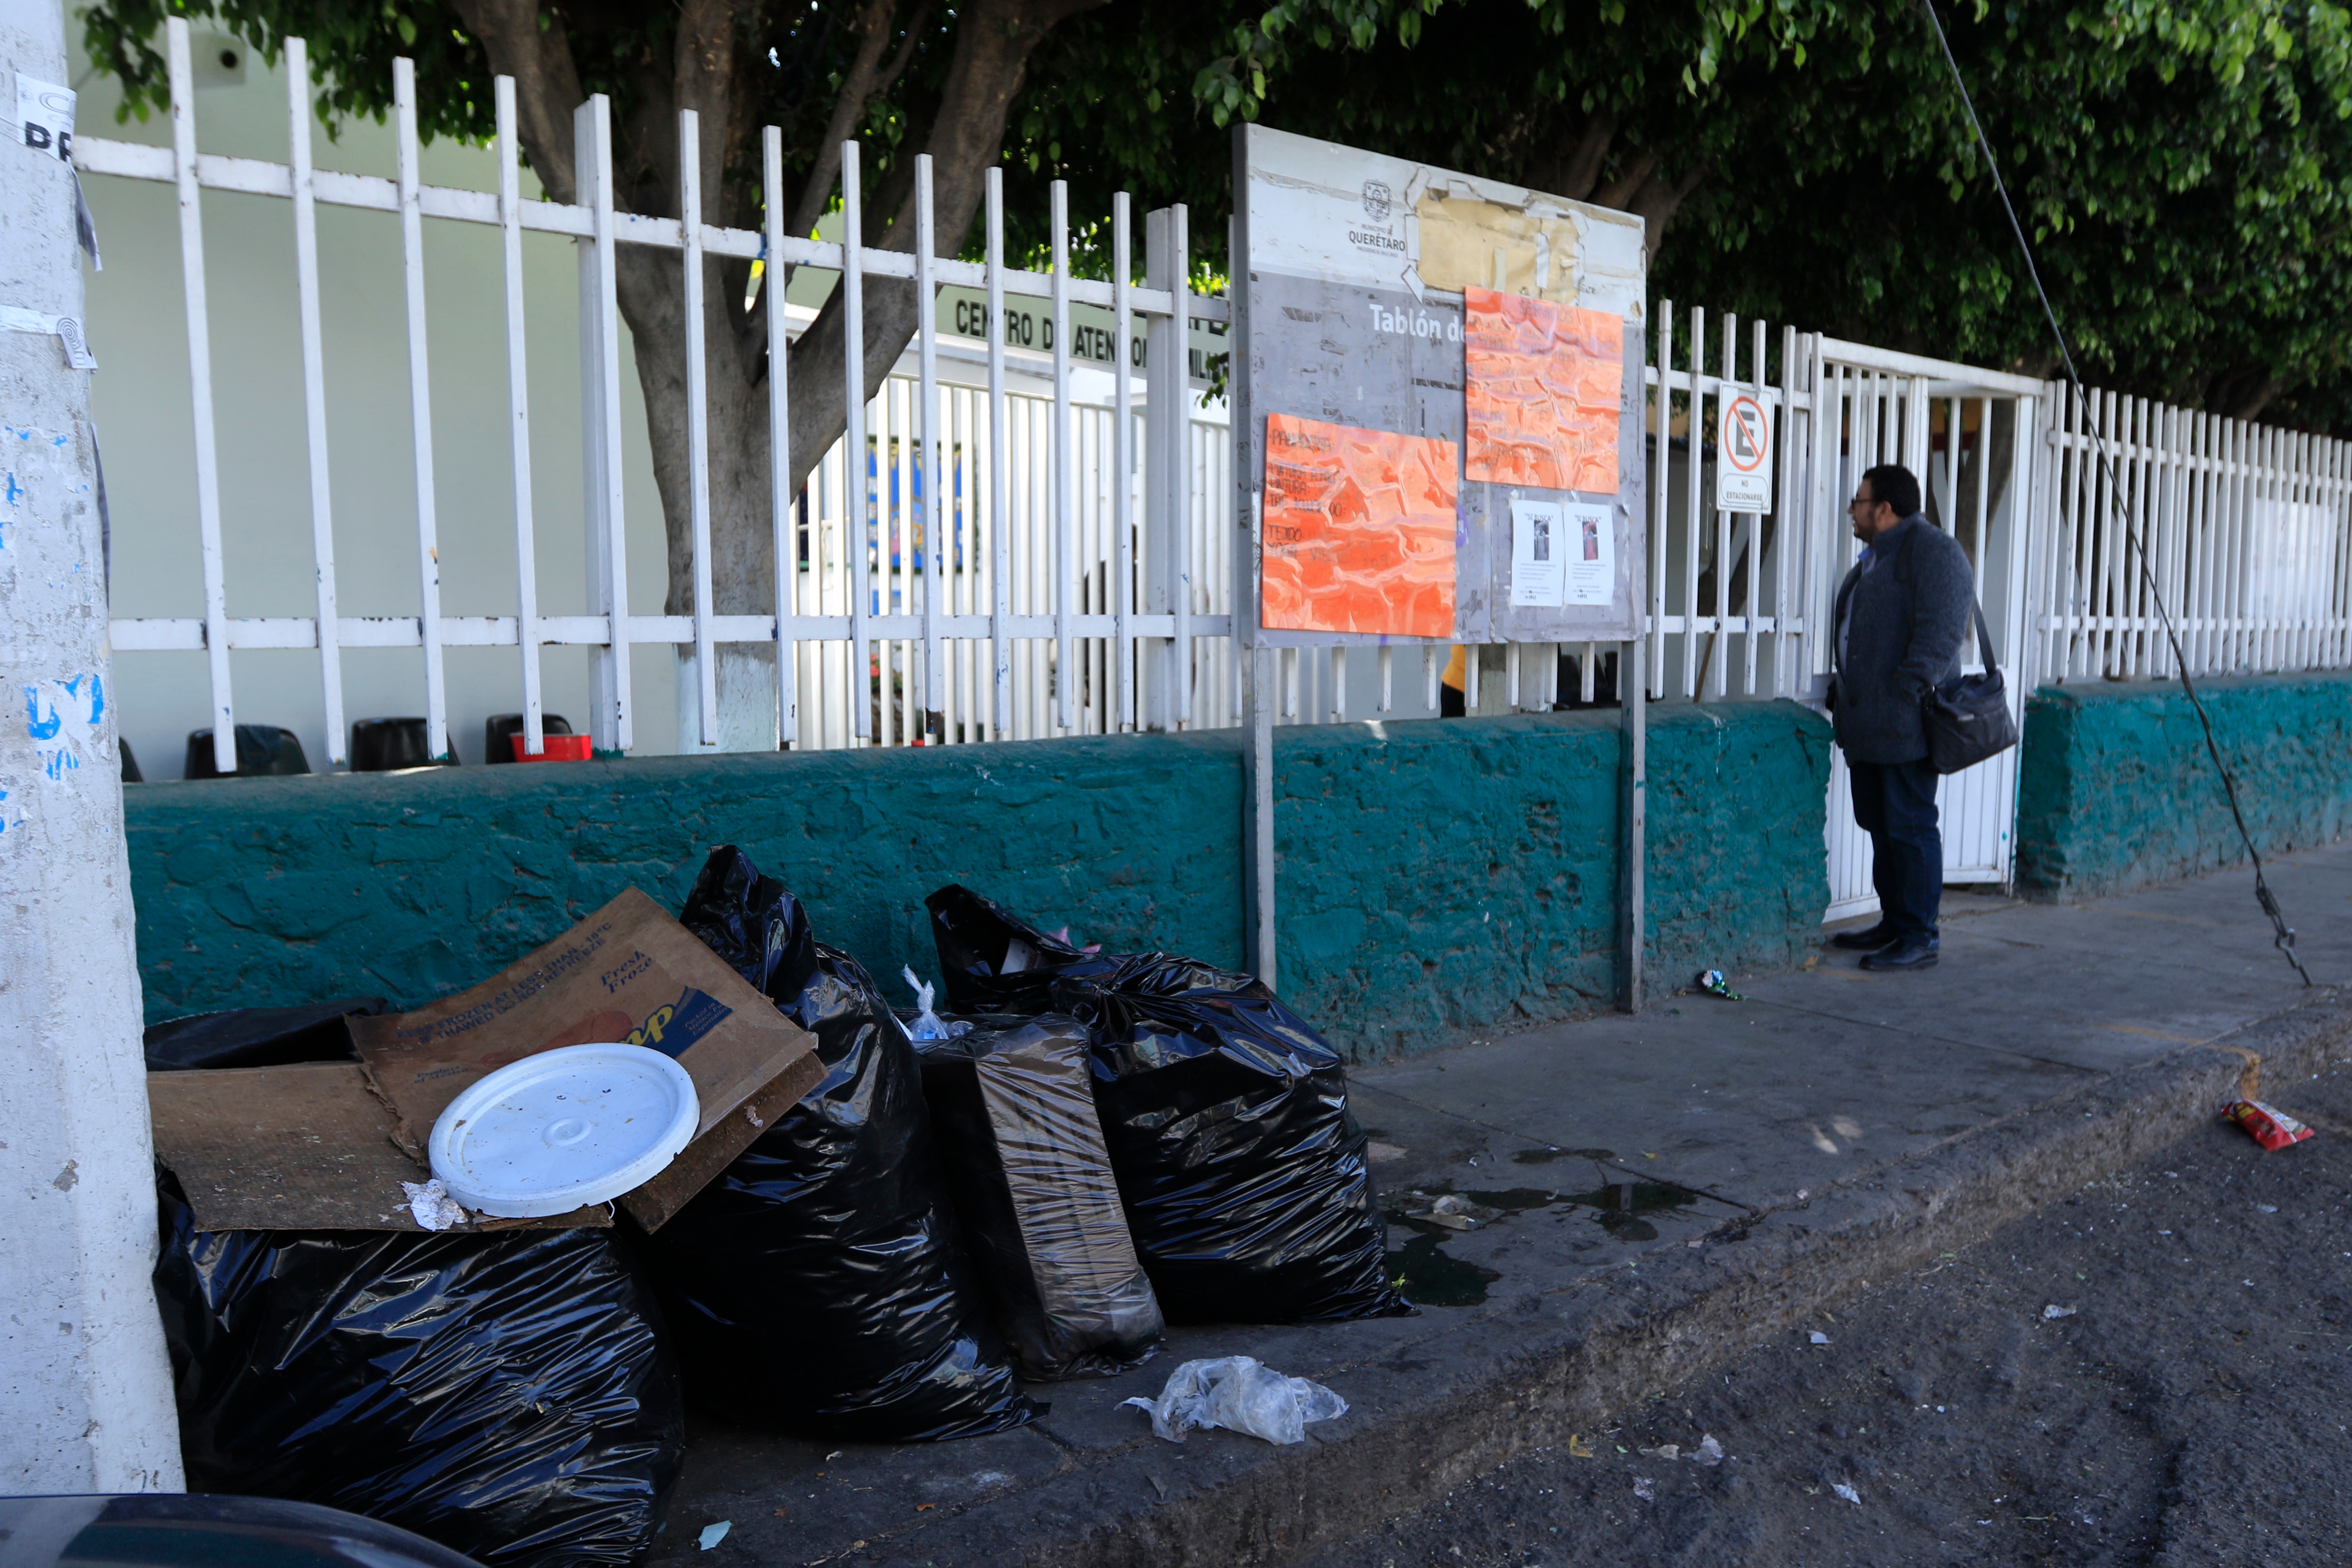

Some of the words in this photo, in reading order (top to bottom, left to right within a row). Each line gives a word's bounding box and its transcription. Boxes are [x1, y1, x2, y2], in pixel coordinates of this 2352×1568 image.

[1349, 230, 1406, 251] QUERÉTARO
[1362, 223, 1386, 233] MUNICIPIO
[956, 299, 1033, 346] CERO
[1074, 324, 1147, 368] ATENO
[1369, 303, 1441, 339] Tablón
[1726, 491, 1763, 501] ESTACIONARSE
[1741, 479, 1749, 487] NO
[601, 950, 645, 986] Fresh
[609, 957, 654, 994] Froze
[436, 1001, 493, 1028] FROZEN
[495, 991, 510, 1008] AT
[512, 971, 544, 994] LESS
[544, 946, 579, 971] THAN
[436, 1012, 495, 1039] THAWED
[518, 982, 544, 1003] NOT
[544, 938, 606, 984] REFREEZE
